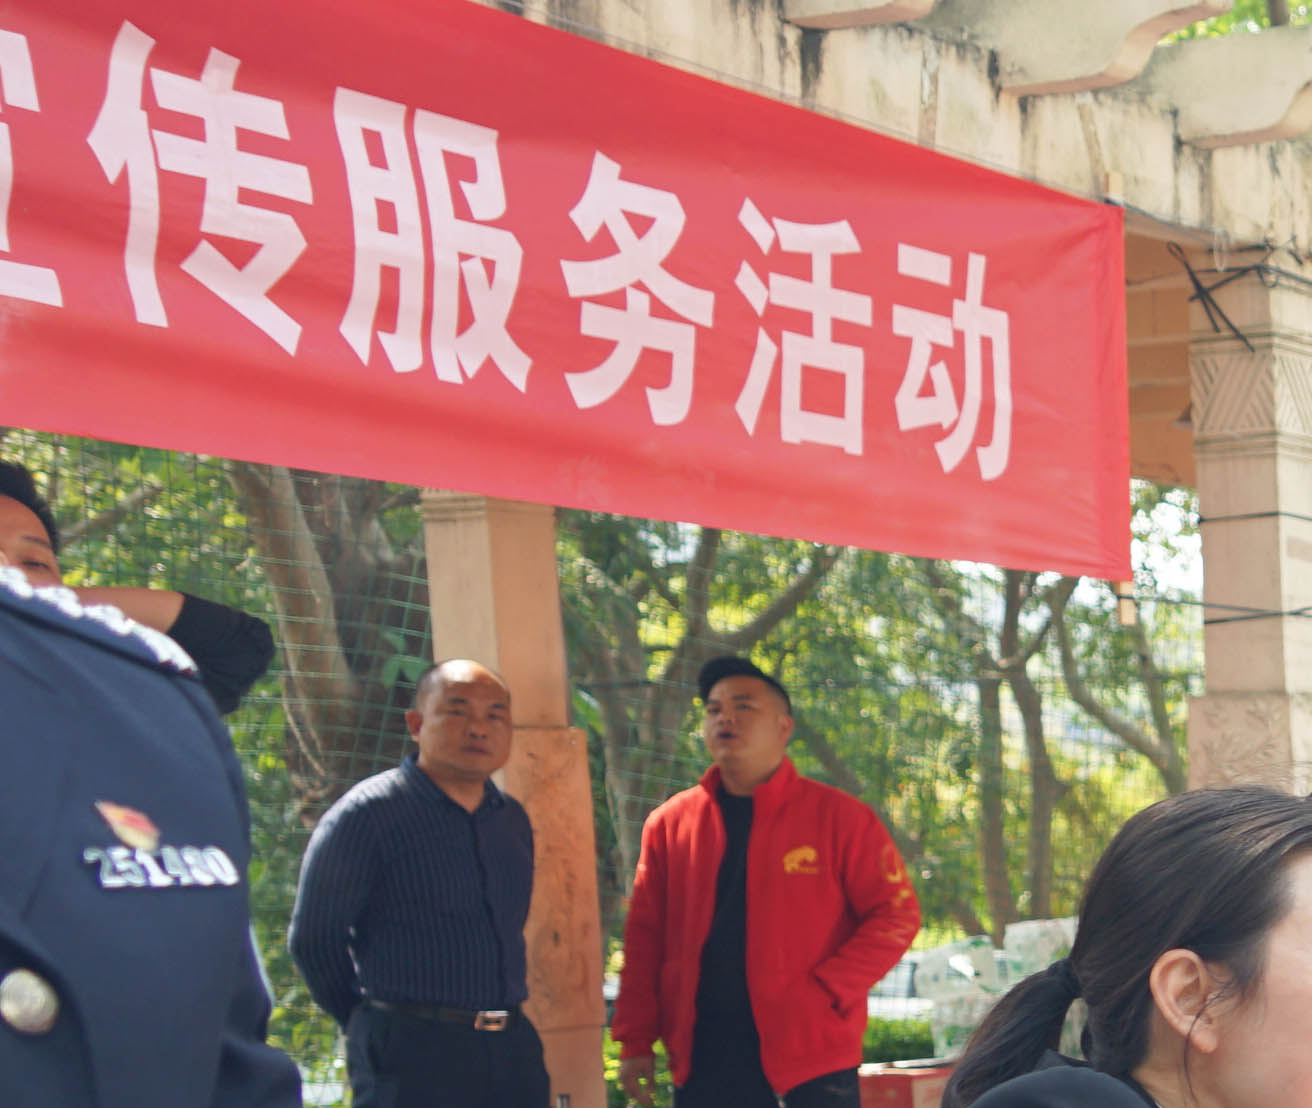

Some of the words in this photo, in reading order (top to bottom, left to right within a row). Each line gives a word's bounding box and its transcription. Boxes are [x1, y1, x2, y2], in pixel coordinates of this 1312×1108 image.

[0, 20, 1013, 481] 传服务活动
